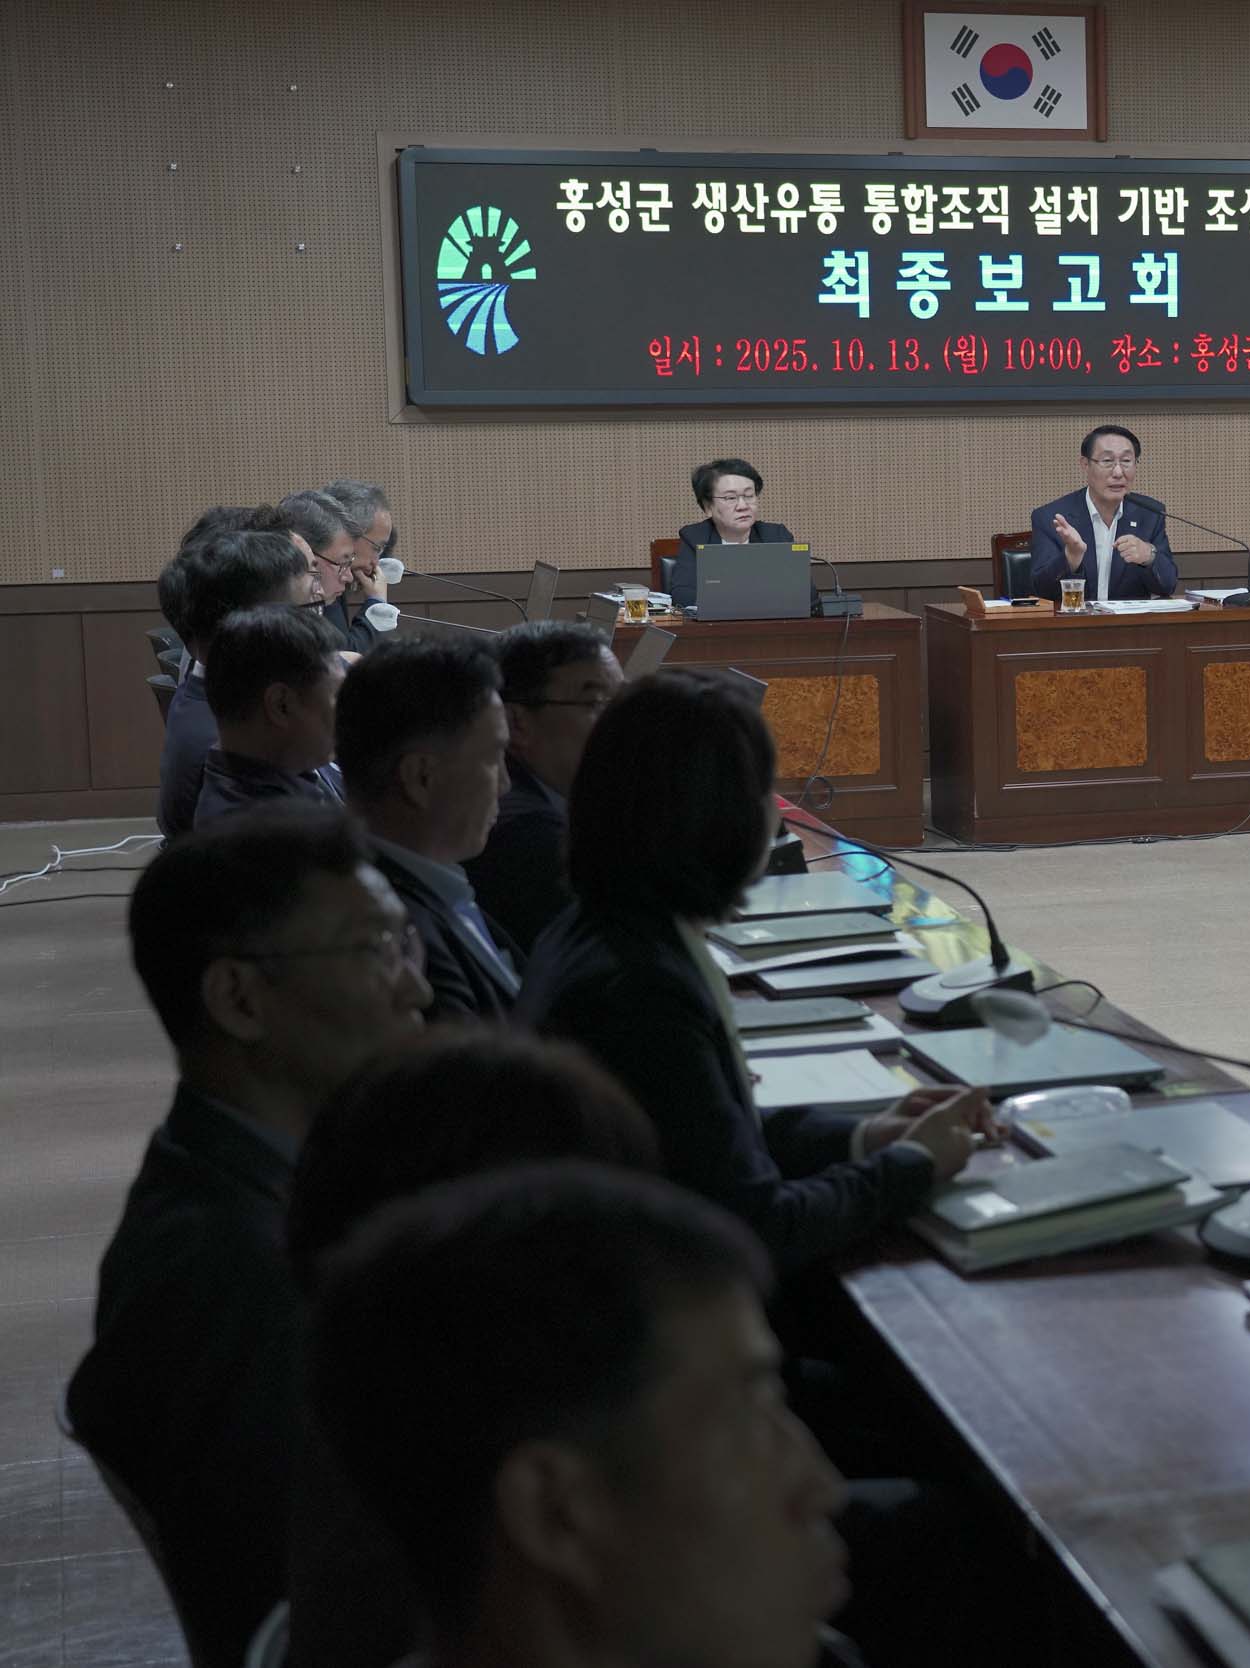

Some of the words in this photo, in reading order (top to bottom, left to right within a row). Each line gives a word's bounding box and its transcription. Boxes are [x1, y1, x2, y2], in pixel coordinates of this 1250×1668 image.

[556, 178, 674, 233] 홍성군
[691, 181, 845, 235] 생산유통
[863, 183, 1009, 235] 통합조직
[1028, 185, 1098, 236] 설치
[1117, 186, 1190, 236] 기반
[648, 335, 701, 377] 일시
[735, 338, 819, 372] 2025.
[831, 338, 876, 372] 10.
[888, 338, 931, 372] 13.
[943, 334, 989, 375] (월)
[1004, 337, 1092, 374] 10:00,
[1111, 333, 1163, 374] 장소
